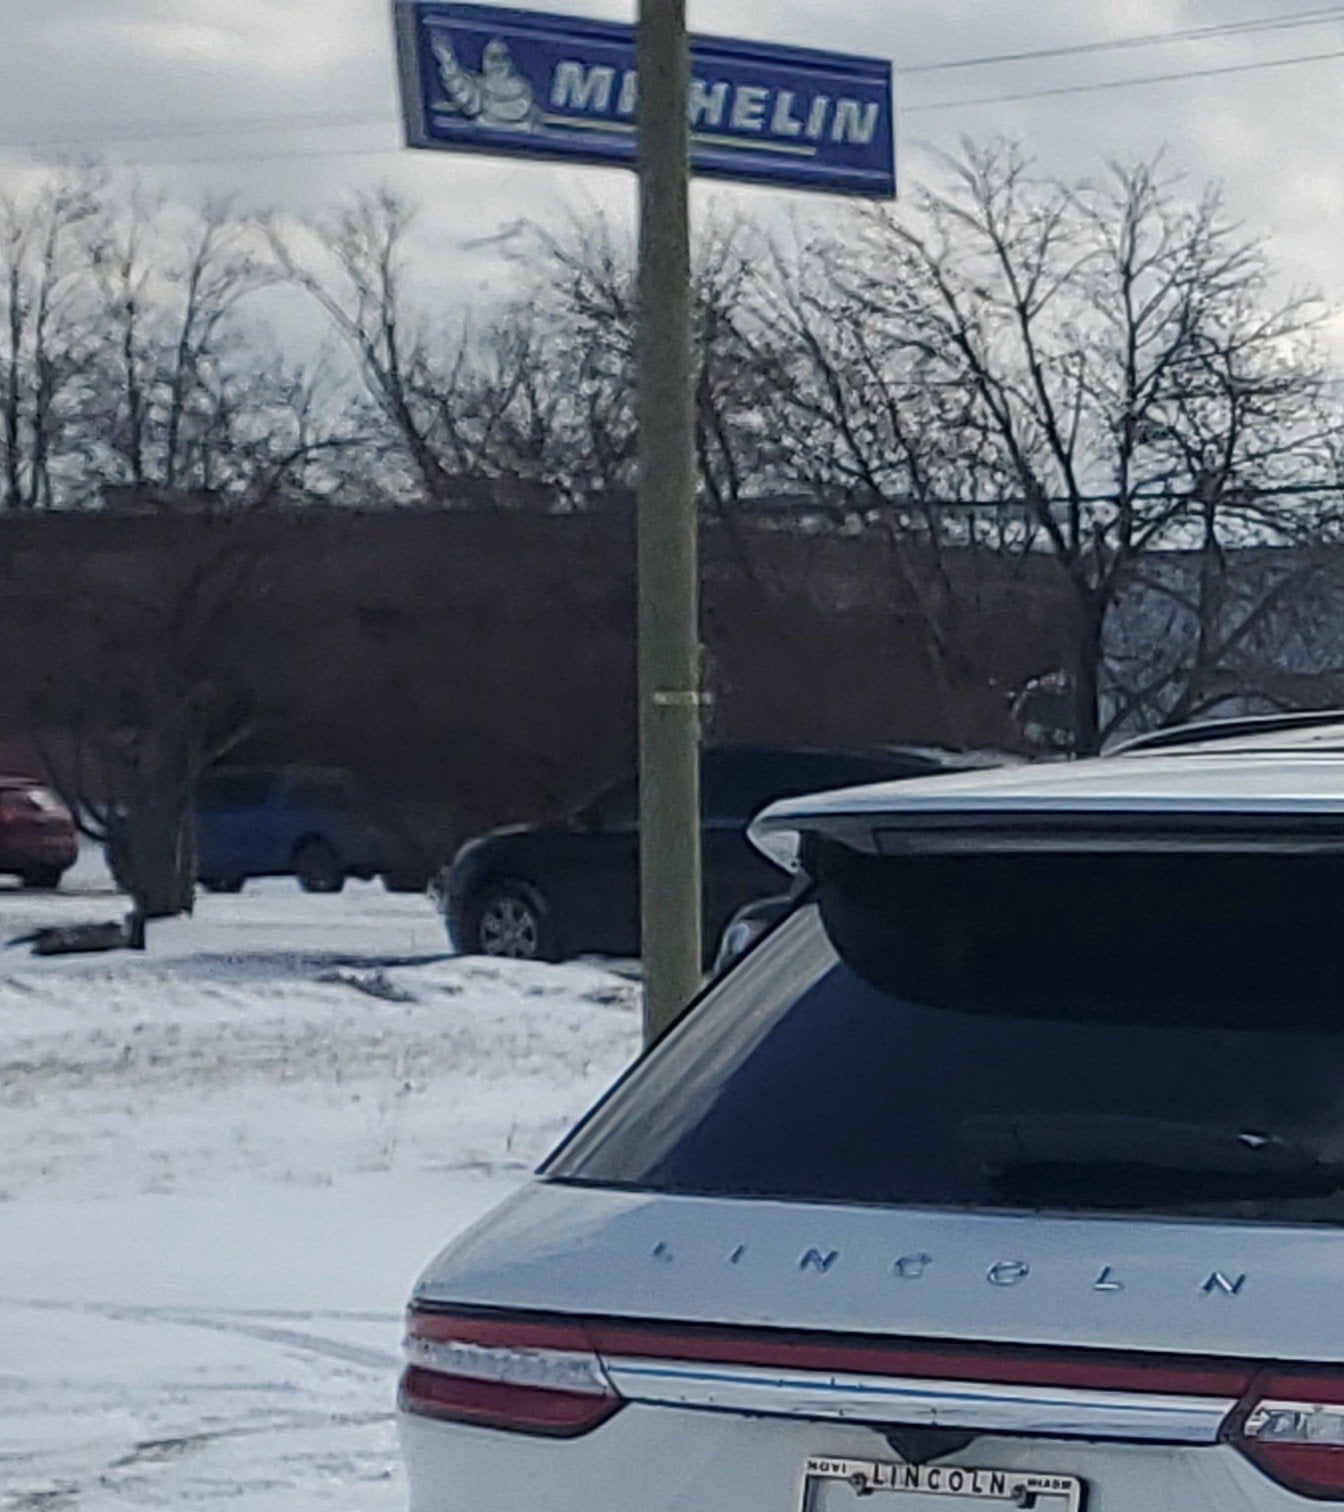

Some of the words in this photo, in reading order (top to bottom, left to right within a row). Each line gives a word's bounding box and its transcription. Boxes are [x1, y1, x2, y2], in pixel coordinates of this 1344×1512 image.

[551, 61, 879, 145] MIHELIN
[651, 1240, 1247, 1296] LINCOLN
[873, 1463, 1005, 1494] LINCOLN
